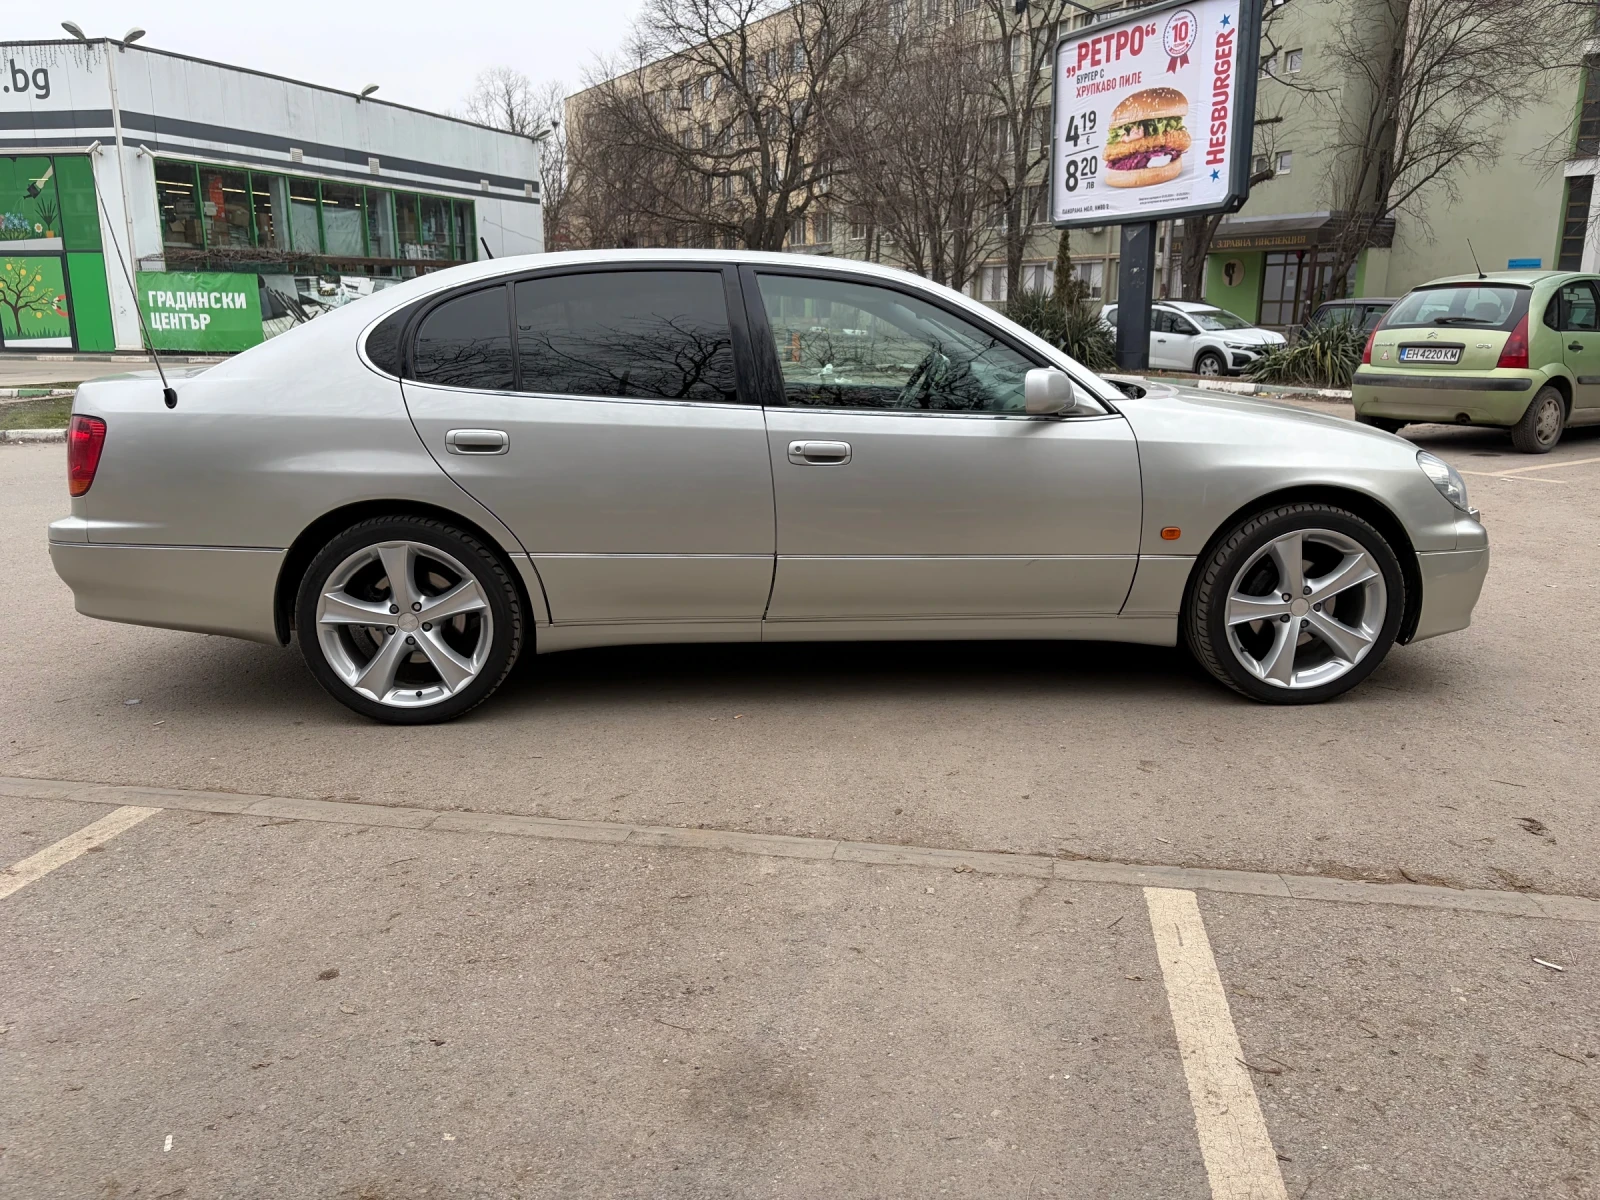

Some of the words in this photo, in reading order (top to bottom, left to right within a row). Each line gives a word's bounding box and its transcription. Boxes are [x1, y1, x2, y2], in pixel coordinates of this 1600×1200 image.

[1172, 21, 1189, 43] 10
[3, 58, 50, 99] .bg
[1076, 70, 1099, 84] БУРГЕР
[1076, 77, 1117, 98] ХРУПКАВО
[1119, 71, 1142, 88] ПИЛЕ
[1205, 28, 1236, 165] HESBURGER
[1216, 239, 1252, 249] ЗДРАВНА
[1255, 235, 1306, 247] ИНСПЕКЦИЯ
[147, 290, 247, 311] ГРАДИНСКИ
[150, 312, 211, 331] ЦЕНТЪР
[1420, 349, 1442, 360] 4220
